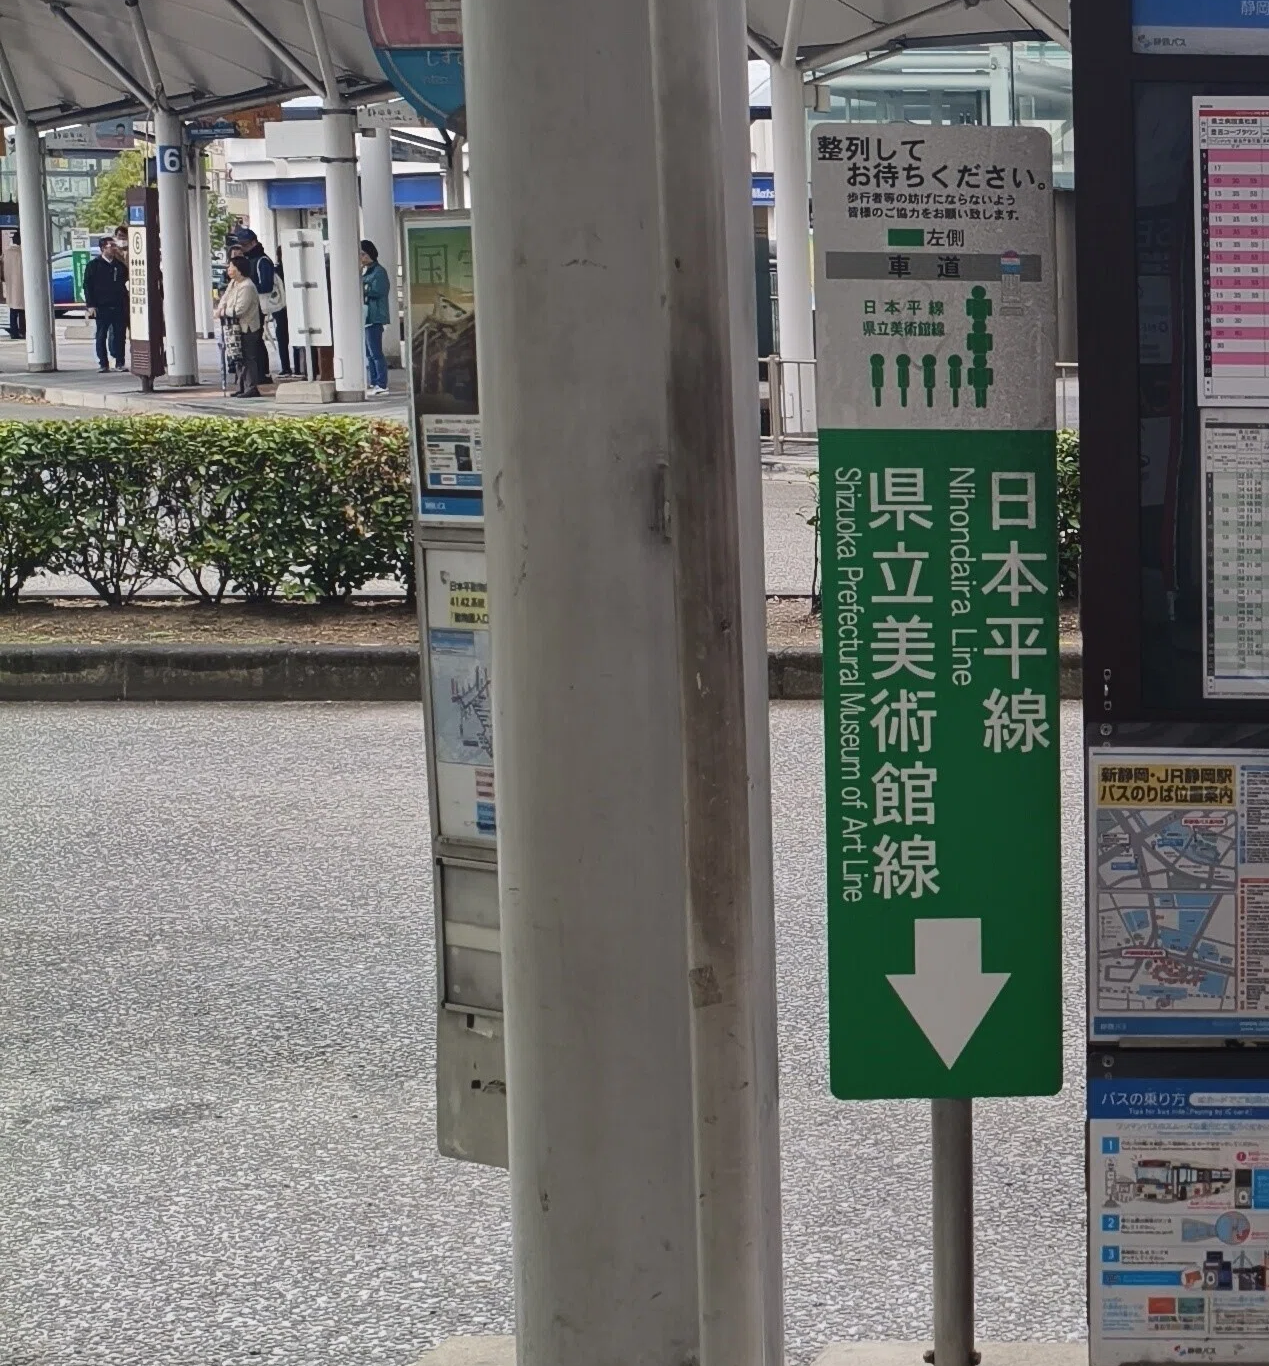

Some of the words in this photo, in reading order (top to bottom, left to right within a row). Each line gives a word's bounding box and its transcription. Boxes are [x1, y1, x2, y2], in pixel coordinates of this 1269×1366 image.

[163, 148, 180, 172] 6
[817, 137, 926, 162] 整列して
[846, 163, 1047, 191] お待ちください。
[847, 192, 1015, 206] 歩行者等の妨げにならないよう
[926, 228, 964, 247] 左側
[864, 300, 944, 316] 日本平線
[863, 321, 945, 337] 県立美術館線
[834, 466, 862, 561] Shizuoka
[949, 466, 976, 617] Nihondaira
[981, 470, 1050, 754] 日本平線
[837, 566, 864, 687] Prefectural
[950, 628, 978, 687] Line
[868, 466, 940, 900] 県立美術館線
[840, 692, 864, 780] Museum
[841, 786, 868, 809] of
[1101, 785, 1233, 804] バスのりば位置案内
[842, 817, 868, 853] Art
[843, 857, 868, 903] Line
[1101, 1092, 1186, 1107] バスの乗り方
